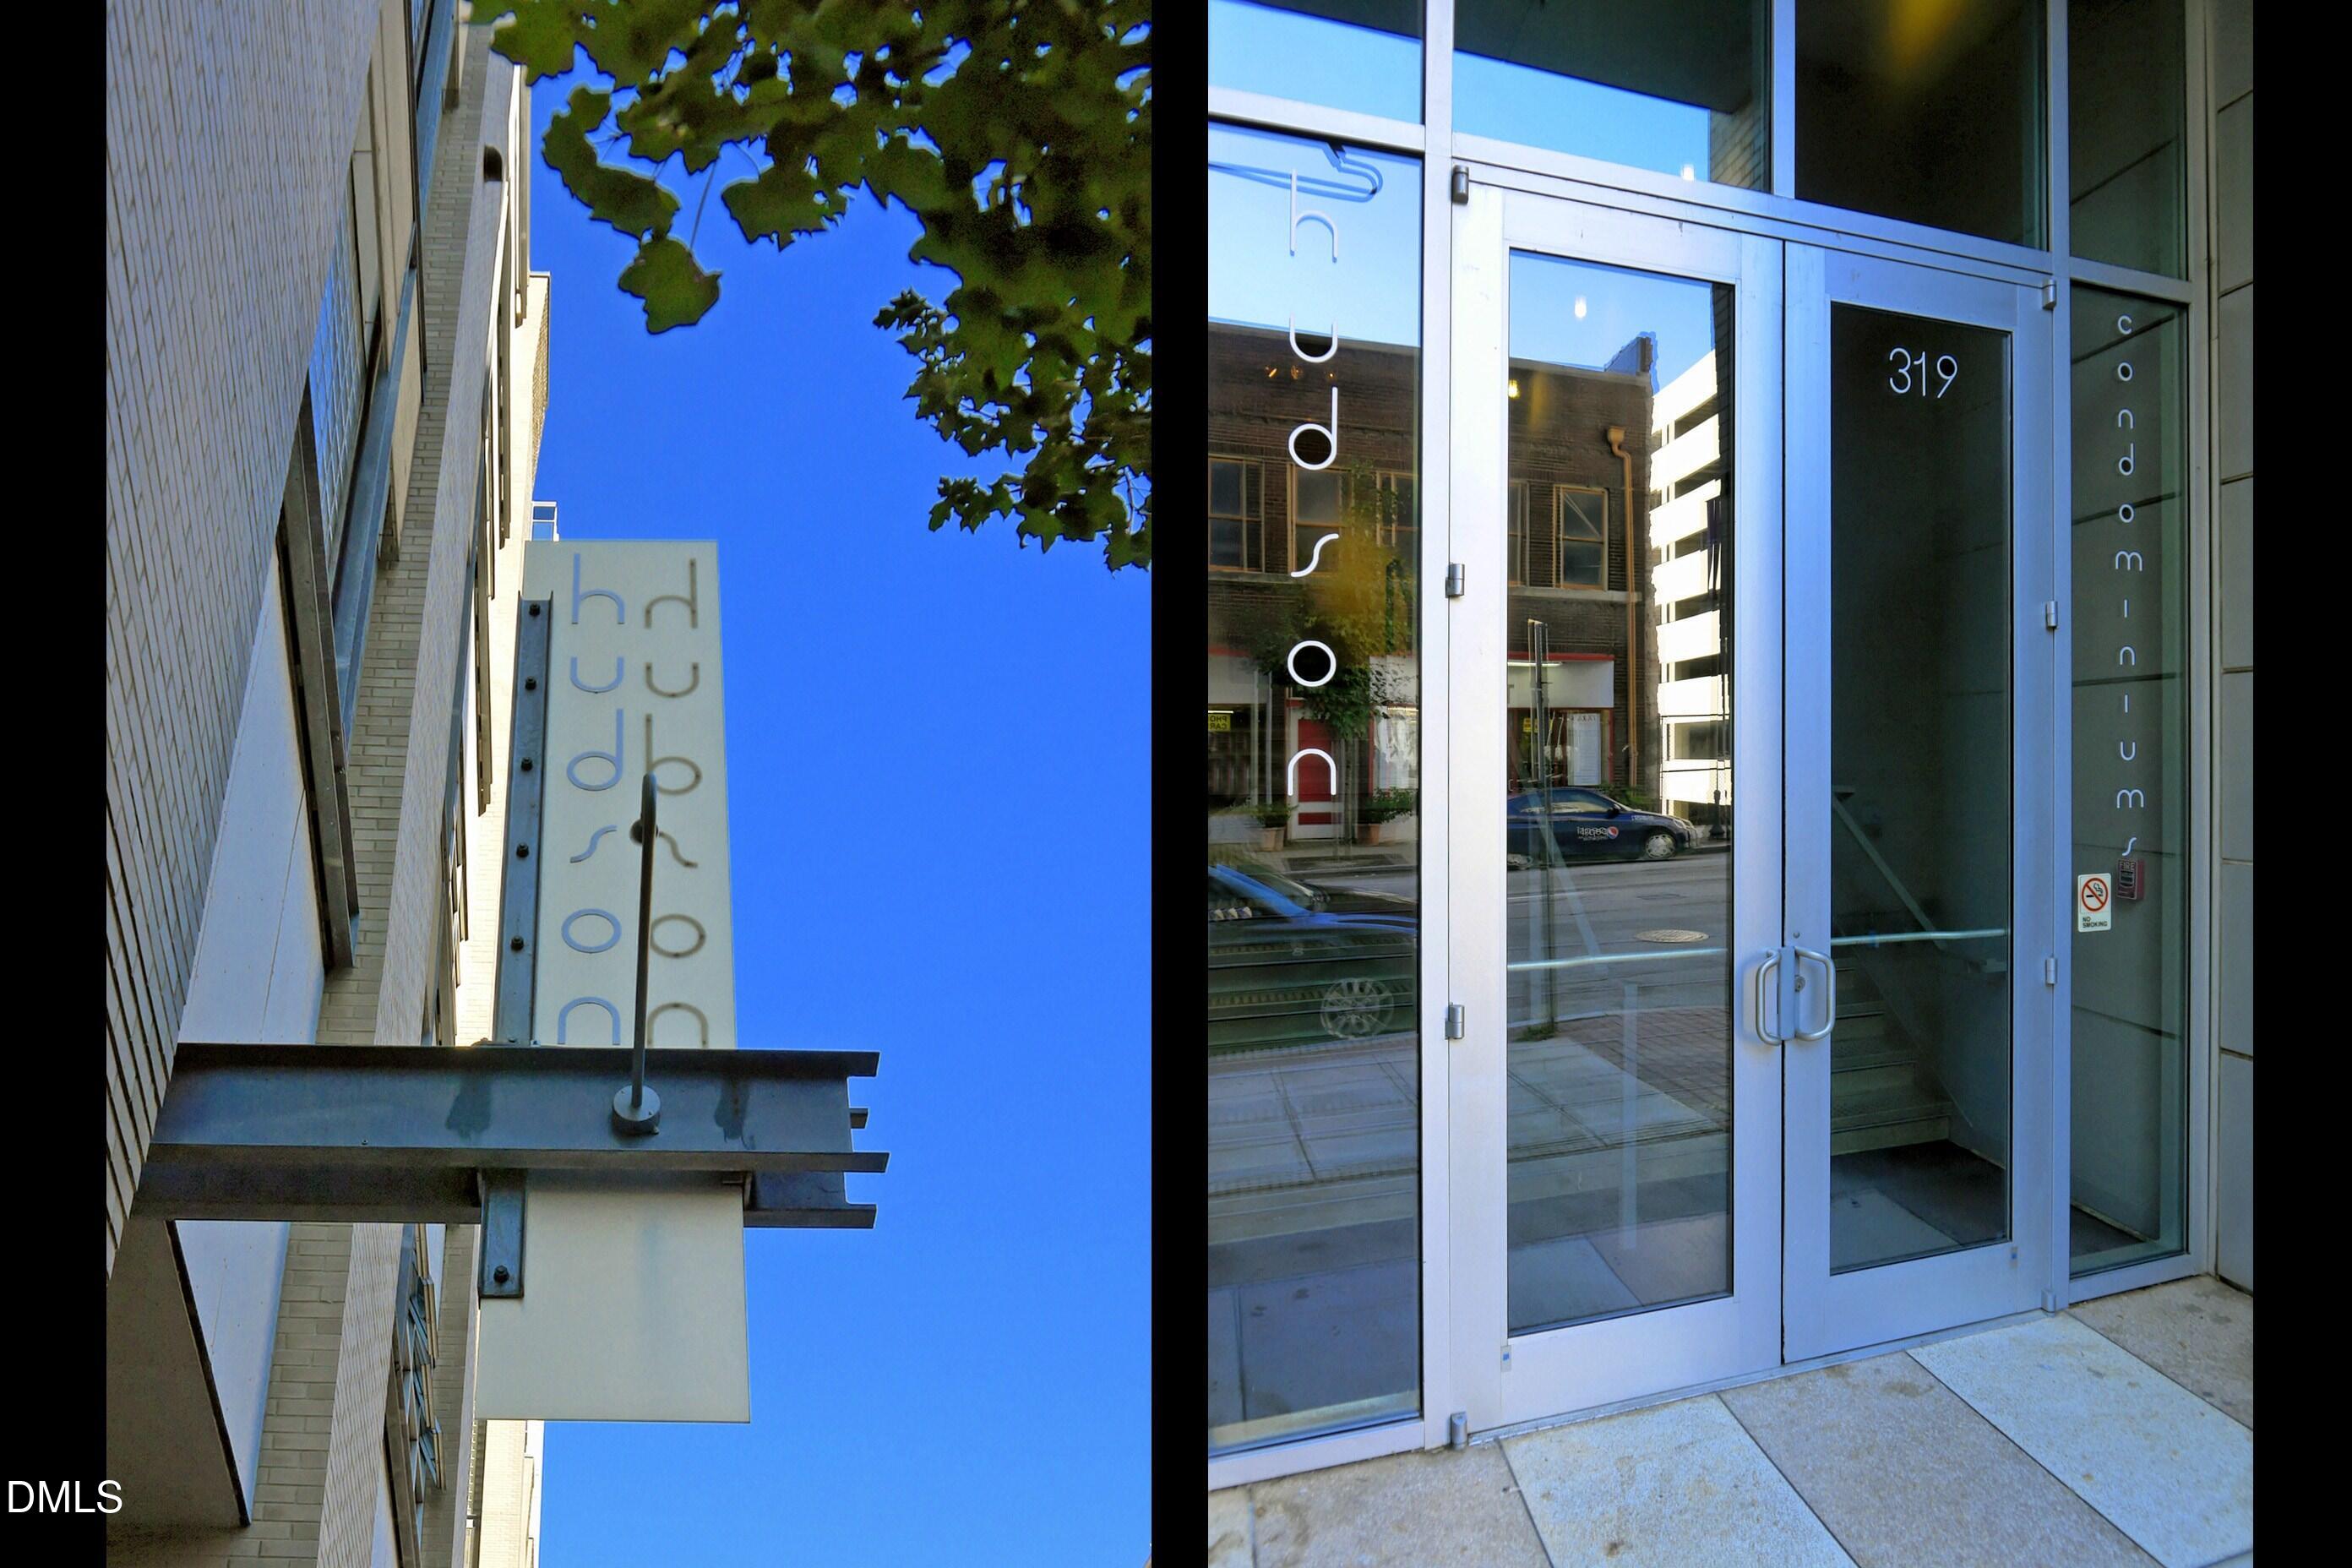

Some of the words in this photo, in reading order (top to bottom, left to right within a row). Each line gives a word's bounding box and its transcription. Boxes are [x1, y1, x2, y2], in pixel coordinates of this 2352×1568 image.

[1287, 169, 1340, 797] hudson
[1889, 347, 1958, 399] 319
[2115, 314, 2143, 856] condominiums
[558, 553, 625, 1045] hudson
